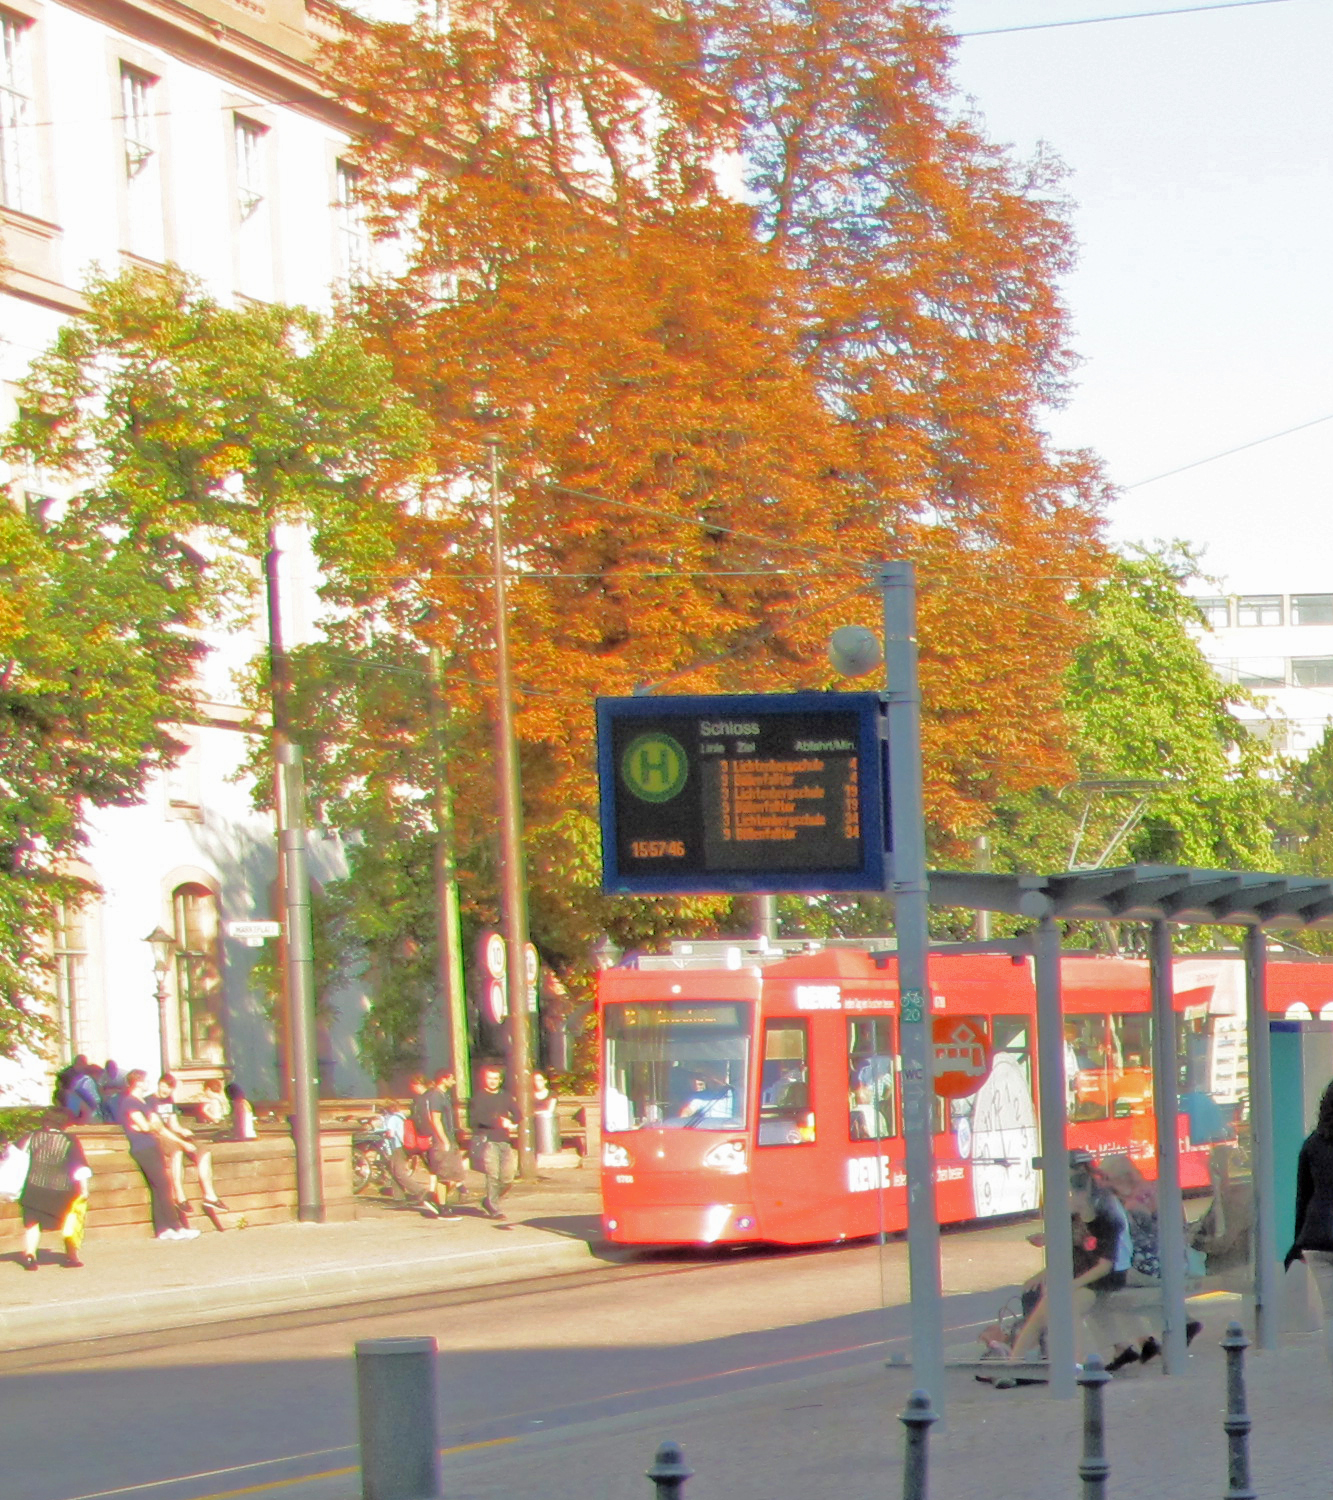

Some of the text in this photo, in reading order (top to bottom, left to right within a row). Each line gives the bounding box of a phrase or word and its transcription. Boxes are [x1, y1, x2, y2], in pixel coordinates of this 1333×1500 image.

[700, 721, 760, 736] Schloss
[904, 1008, 920, 1021] 20
[905, 1069, 922, 1080] WC
[848, 1155, 890, 1192] REWE
